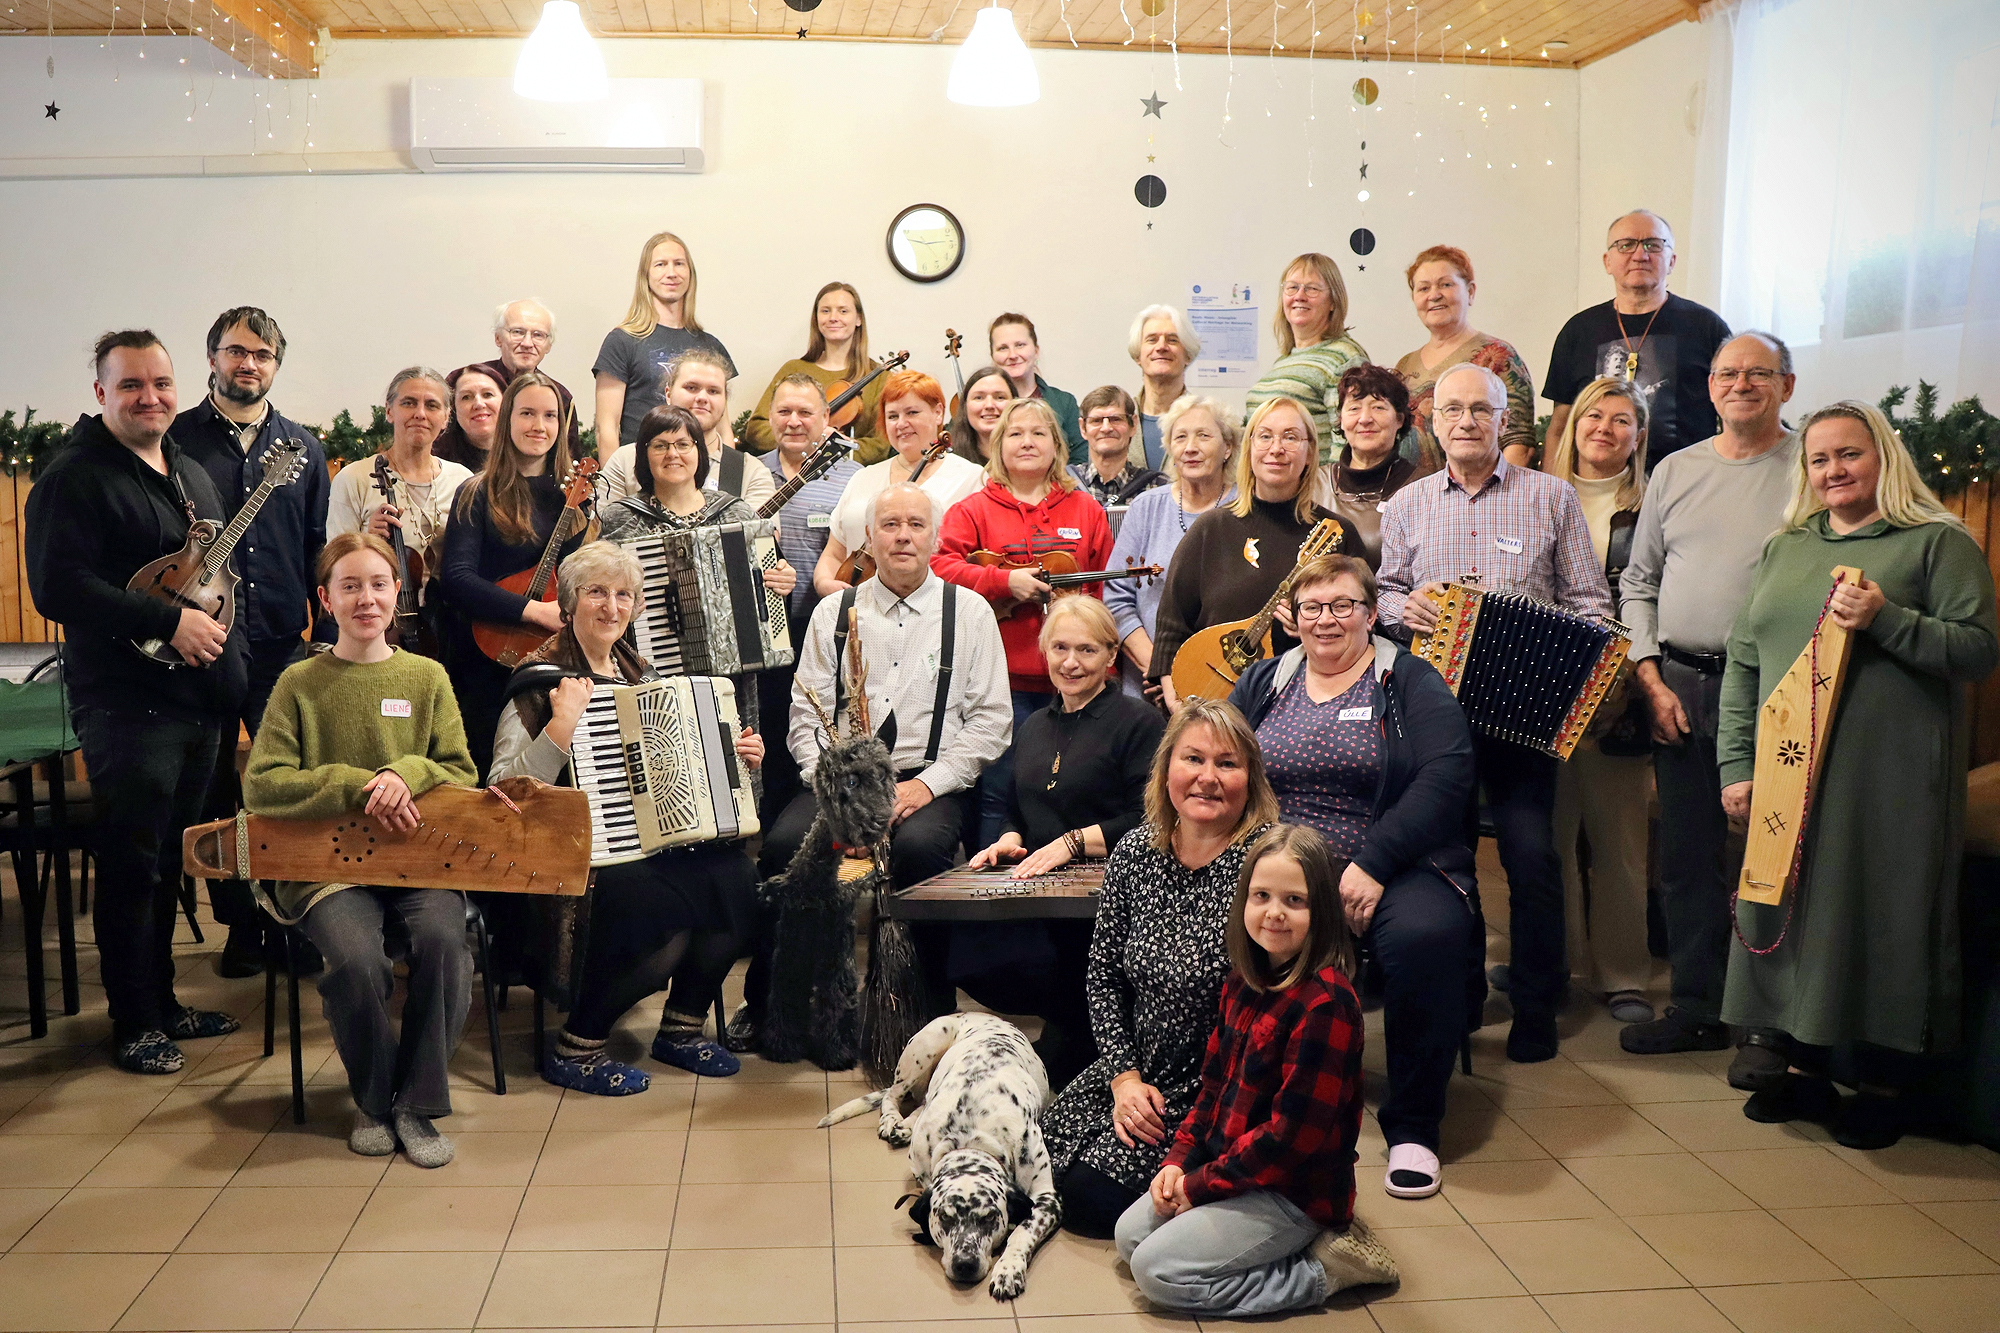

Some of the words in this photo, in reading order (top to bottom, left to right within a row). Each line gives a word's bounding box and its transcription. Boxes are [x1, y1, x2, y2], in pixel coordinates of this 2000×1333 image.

[1497, 536, 1521, 547] VALTERS
[384, 703, 410, 713] LIENE
[698, 767, 707, 799] Dino
